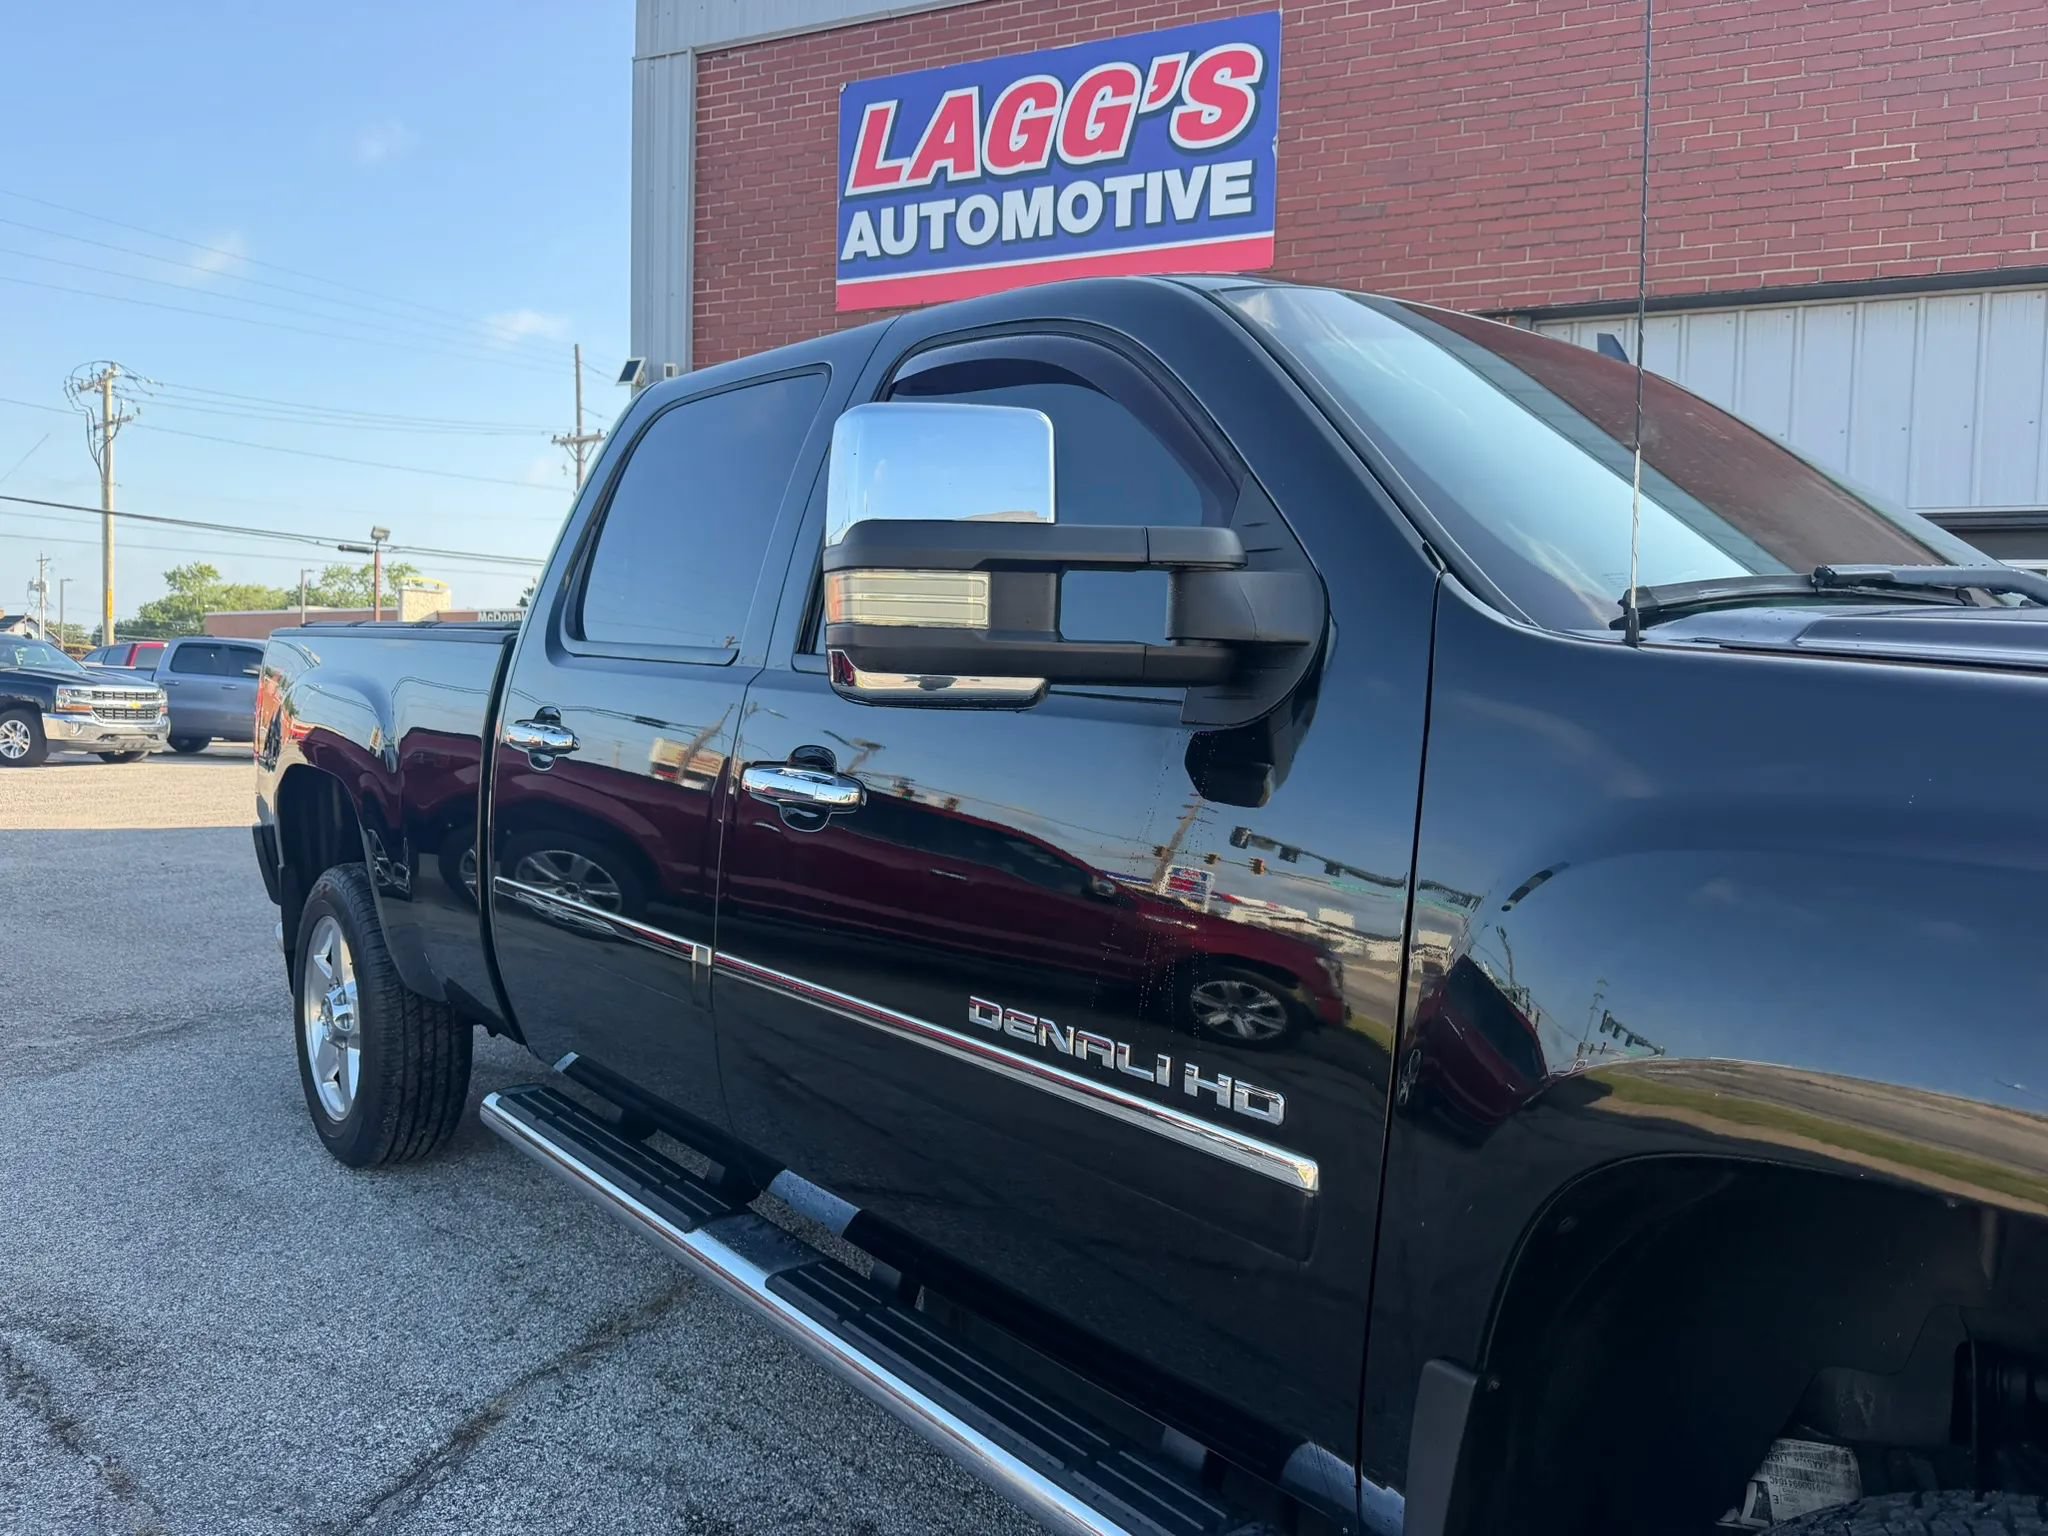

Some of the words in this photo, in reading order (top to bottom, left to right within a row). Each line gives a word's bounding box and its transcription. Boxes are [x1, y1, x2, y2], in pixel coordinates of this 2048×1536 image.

[845, 42, 1265, 196] LAGG'S
[840, 159, 1254, 261] AUTOMOTIVE
[968, 995, 1172, 1087] DENALI
[1184, 1063, 1287, 1126] HD
